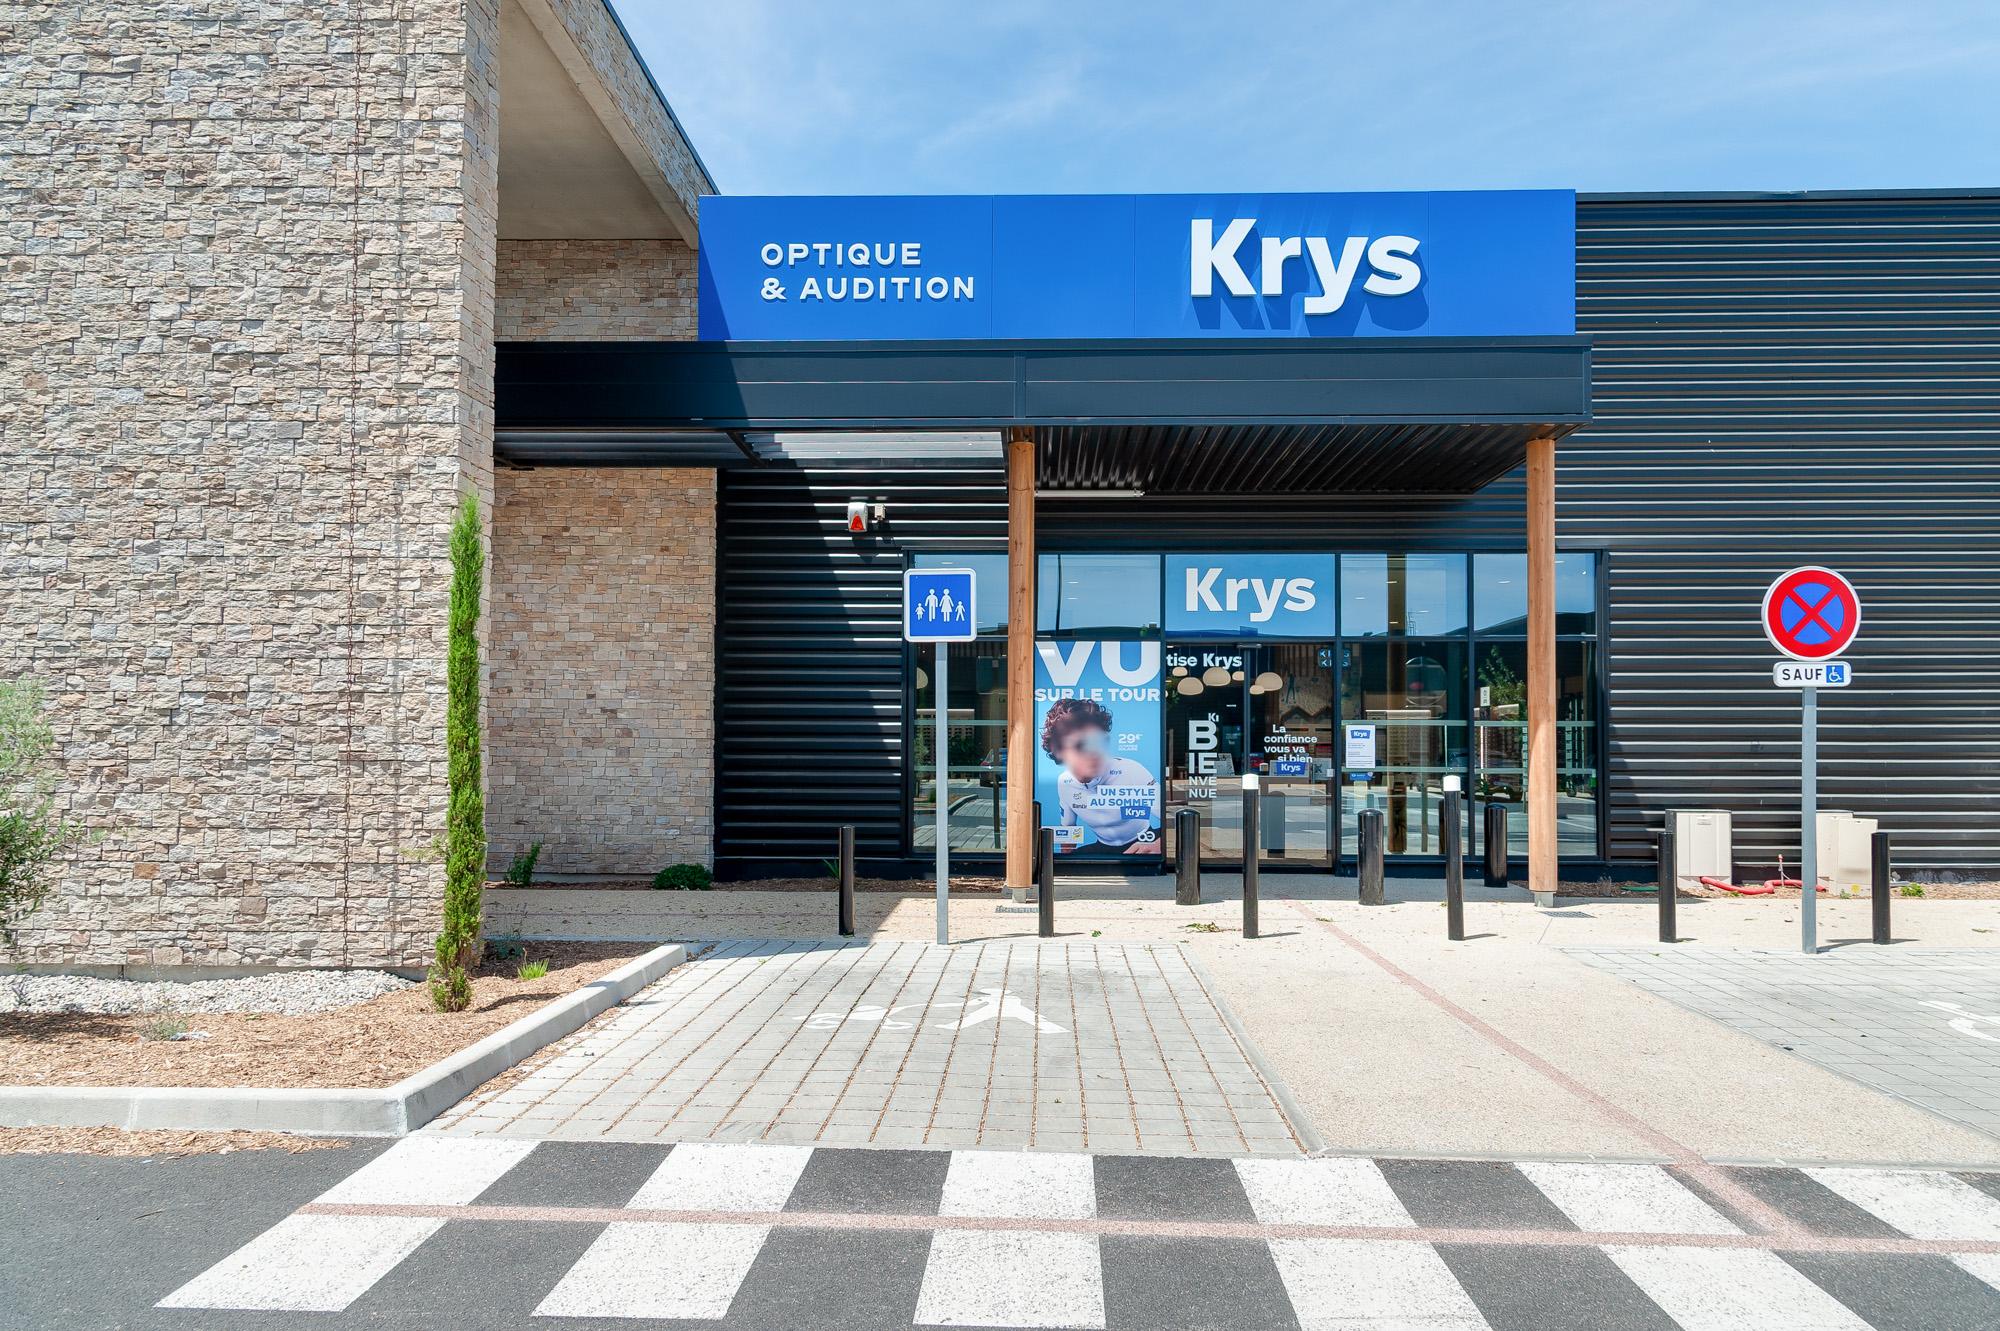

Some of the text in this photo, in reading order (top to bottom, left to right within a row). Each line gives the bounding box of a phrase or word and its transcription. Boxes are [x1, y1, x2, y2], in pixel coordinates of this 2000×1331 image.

[760, 242, 921, 267] OPTIQUE
[1191, 218, 1422, 315] Krys
[760, 276, 975, 300] & AUDITION
[1185, 567, 1316, 622] Krys
[1035, 641, 1161, 687] VU
[1202, 653, 1242, 670] Krys
[1782, 668, 1823, 681] SAUF
[1035, 688, 1160, 702] SUR LE TOUR
[1272, 724, 1286, 733] La
[1263, 734, 1317, 743] confiance
[1263, 745, 1306, 753] vous va
[1278, 755, 1313, 763] si bien
[1280, 763, 1302, 773] Krys
[1188, 776, 1217, 786] NVE
[1100, 788, 1156, 797] UN STYLE
[1188, 789, 1217, 799] NUE
[1090, 798, 1106, 806] AU
[1108, 798, 1155, 807] SOMMET
[1125, 807, 1146, 817] Krys
